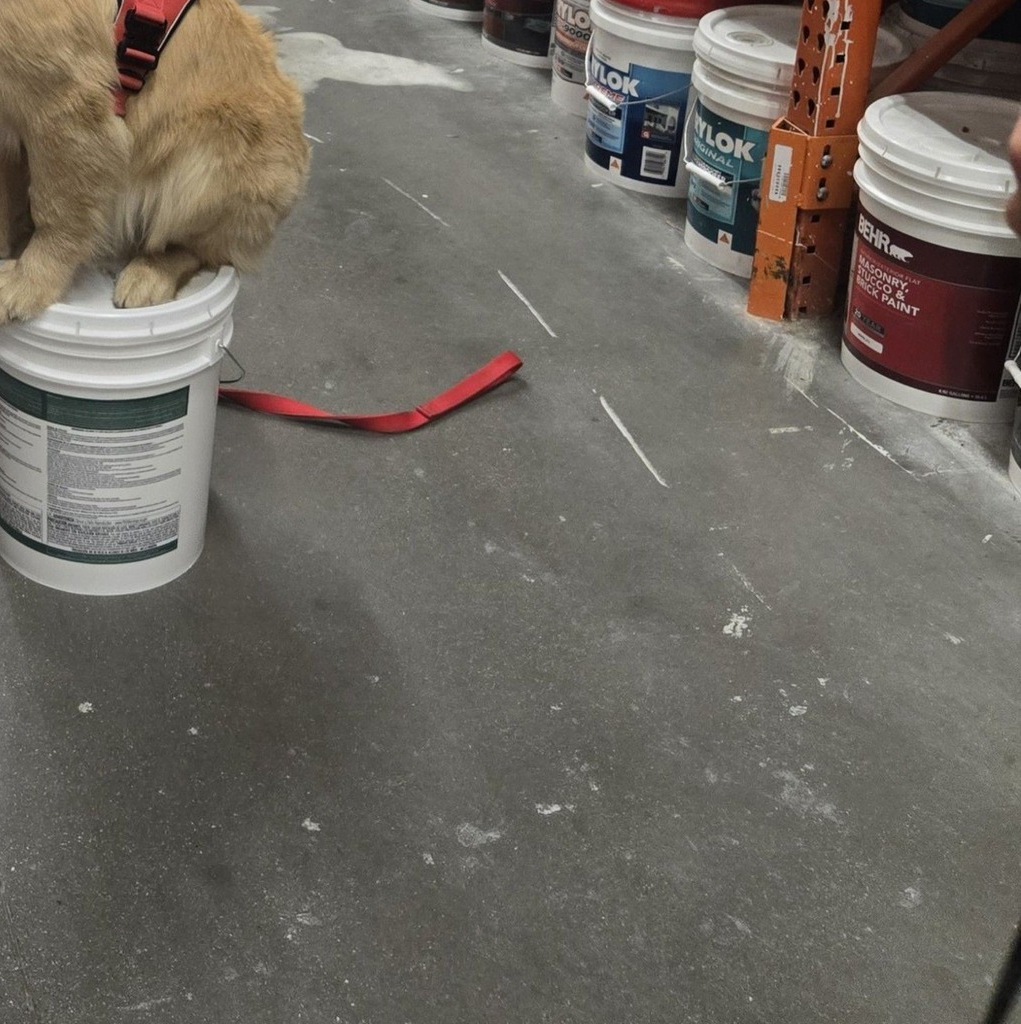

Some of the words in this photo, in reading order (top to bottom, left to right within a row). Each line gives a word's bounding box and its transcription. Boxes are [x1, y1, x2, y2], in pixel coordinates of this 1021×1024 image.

[857, 213, 891, 255] BEHR
[857, 264, 893, 296] STUCCO
[895, 289, 906, 302] &
[858, 253, 910, 294] MASONRY,
[855, 274, 880, 300] BRICK
[881, 293, 921, 318] PAINT
